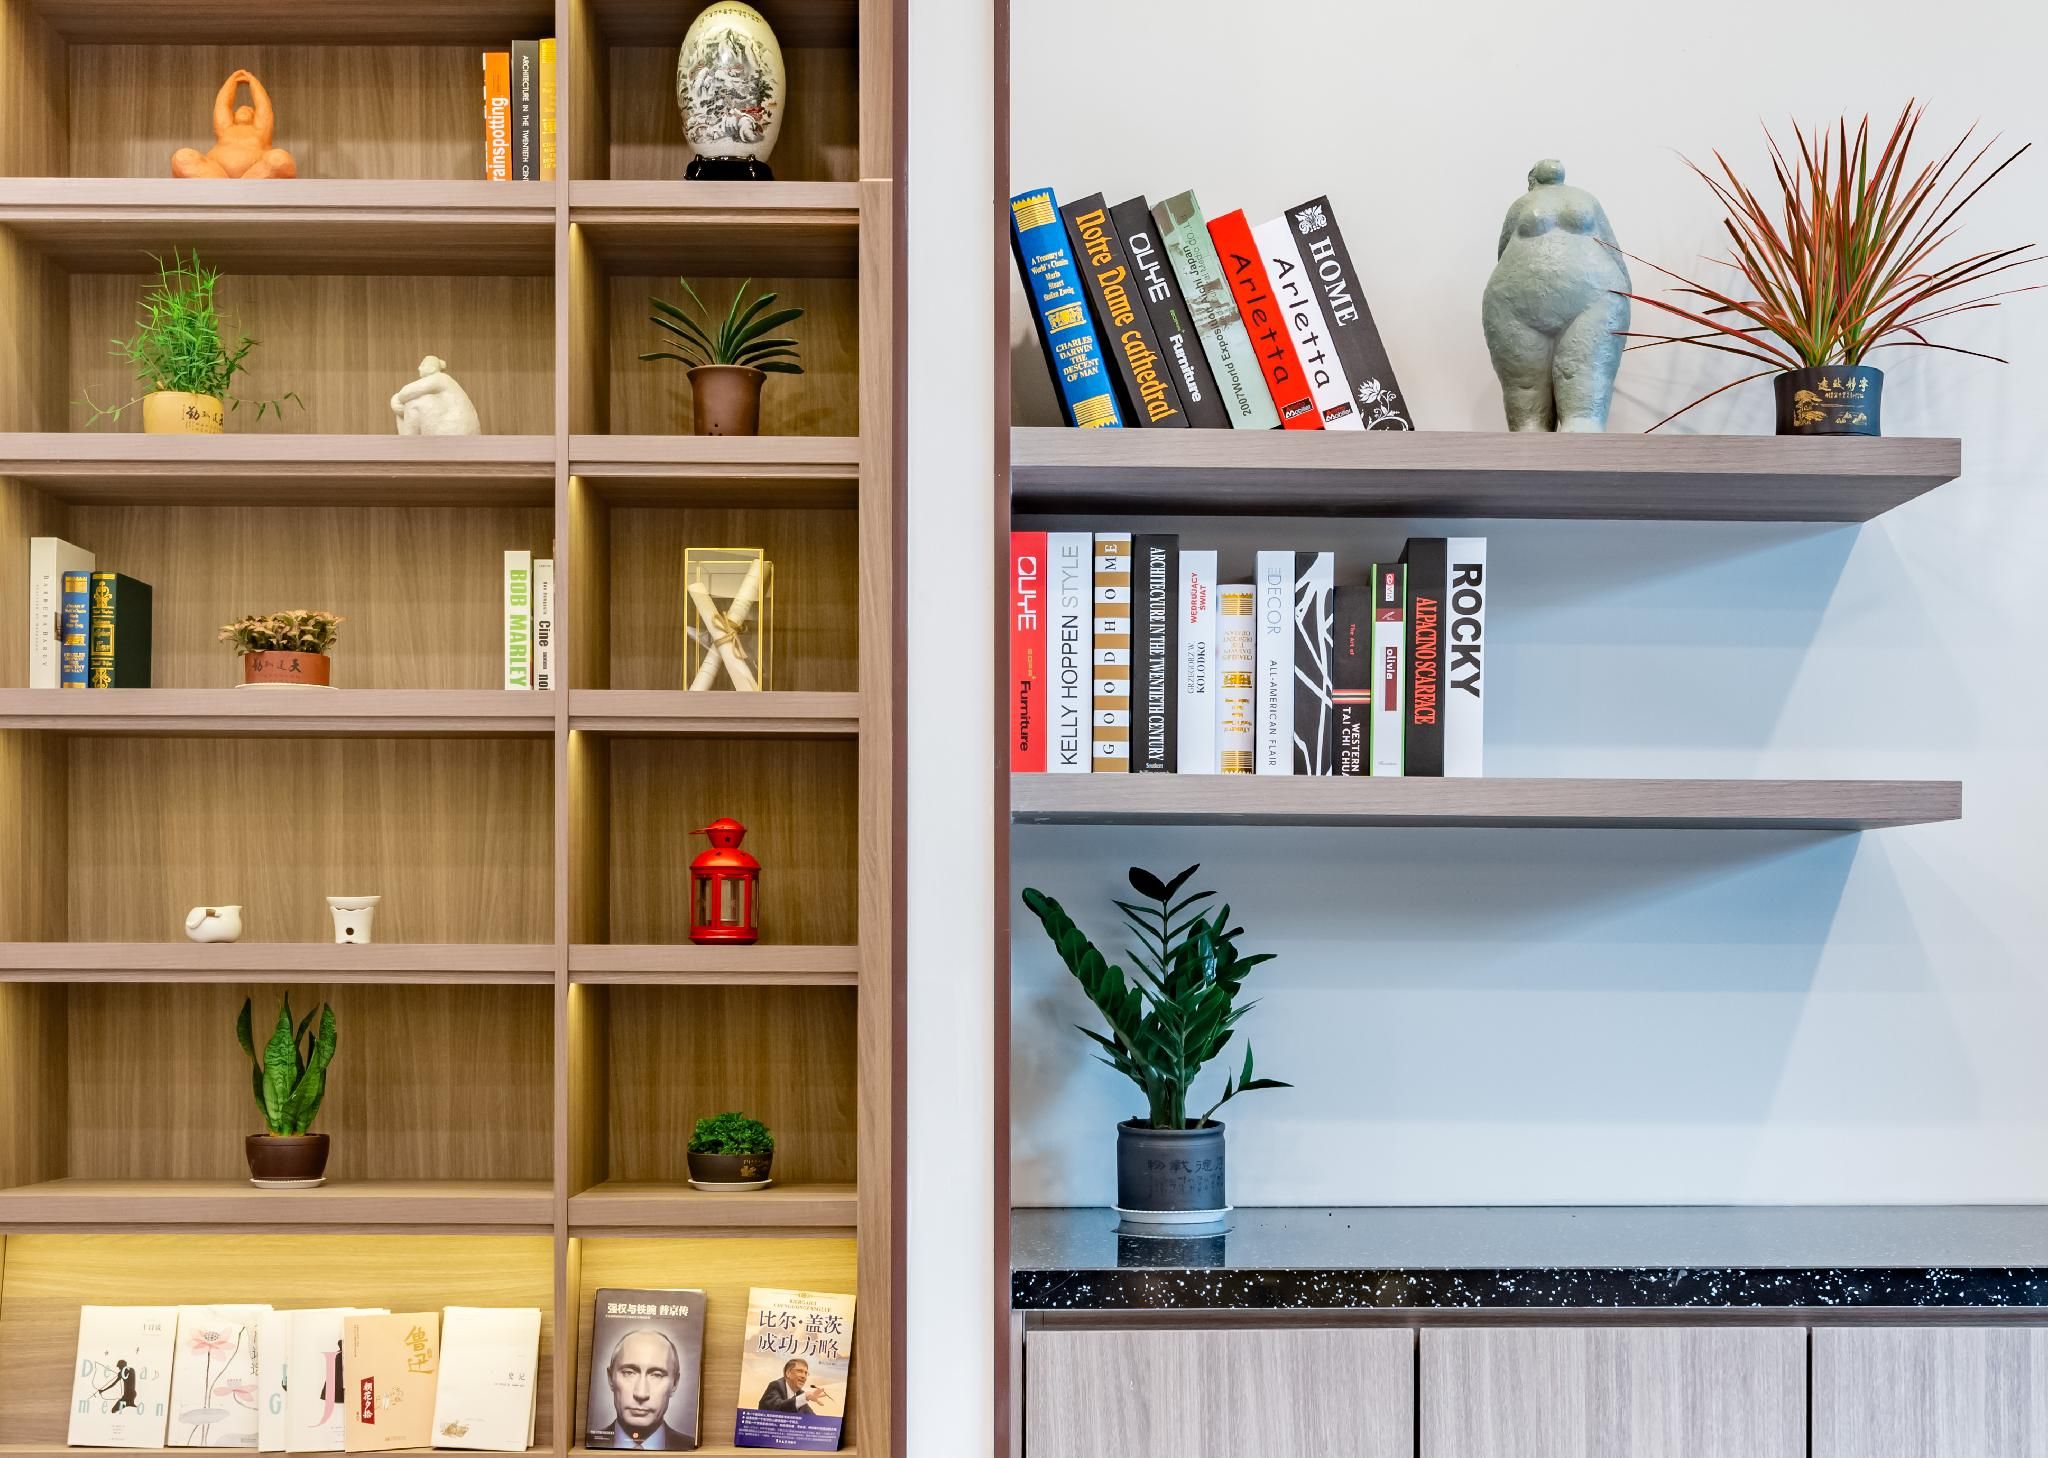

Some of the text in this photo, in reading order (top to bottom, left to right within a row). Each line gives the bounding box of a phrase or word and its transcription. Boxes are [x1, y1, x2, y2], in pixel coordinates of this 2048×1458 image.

[522, 55, 530, 102] ARCHITECTURE
[1308, 235, 1359, 327] HOME
[1075, 208, 1179, 423] Notre Dame cathedral
[1229, 253, 1289, 385] Arletta
[1272, 258, 1330, 389] Arletta
[1055, 335, 1093, 353] CHARLES
[1059, 344, 1093, 360] DARWIN
[1063, 357, 1100, 376] DESCENT
[1069, 353, 1088, 365] THE
[1169, 333, 1202, 403] Furniture
[1079, 366, 1099, 379] MAN
[509, 570, 528, 687] BOB MARLEY
[538, 620, 551, 647] Cine
[1149, 635, 1165, 656] THE
[1450, 563, 1483, 699] ROCKY
[1060, 544, 1079, 766] KELLY HOPPEN STYLE
[1386, 648, 1396, 680] olivia
[1148, 657, 1165, 714] TWENTIETH
[1414, 660, 1437, 726] SCARFACE
[1020, 681, 1032, 752] Furniture
[1268, 659, 1278, 767] ALL-AMERICAN FLAIR
[1341, 728, 1351, 746] CHI
[1342, 706, 1352, 726] TAI
[1148, 715, 1165, 761] CENTURY
[1351, 722, 1361, 773] WESTERN
[758, 1333, 839, 1359] 成功方略
